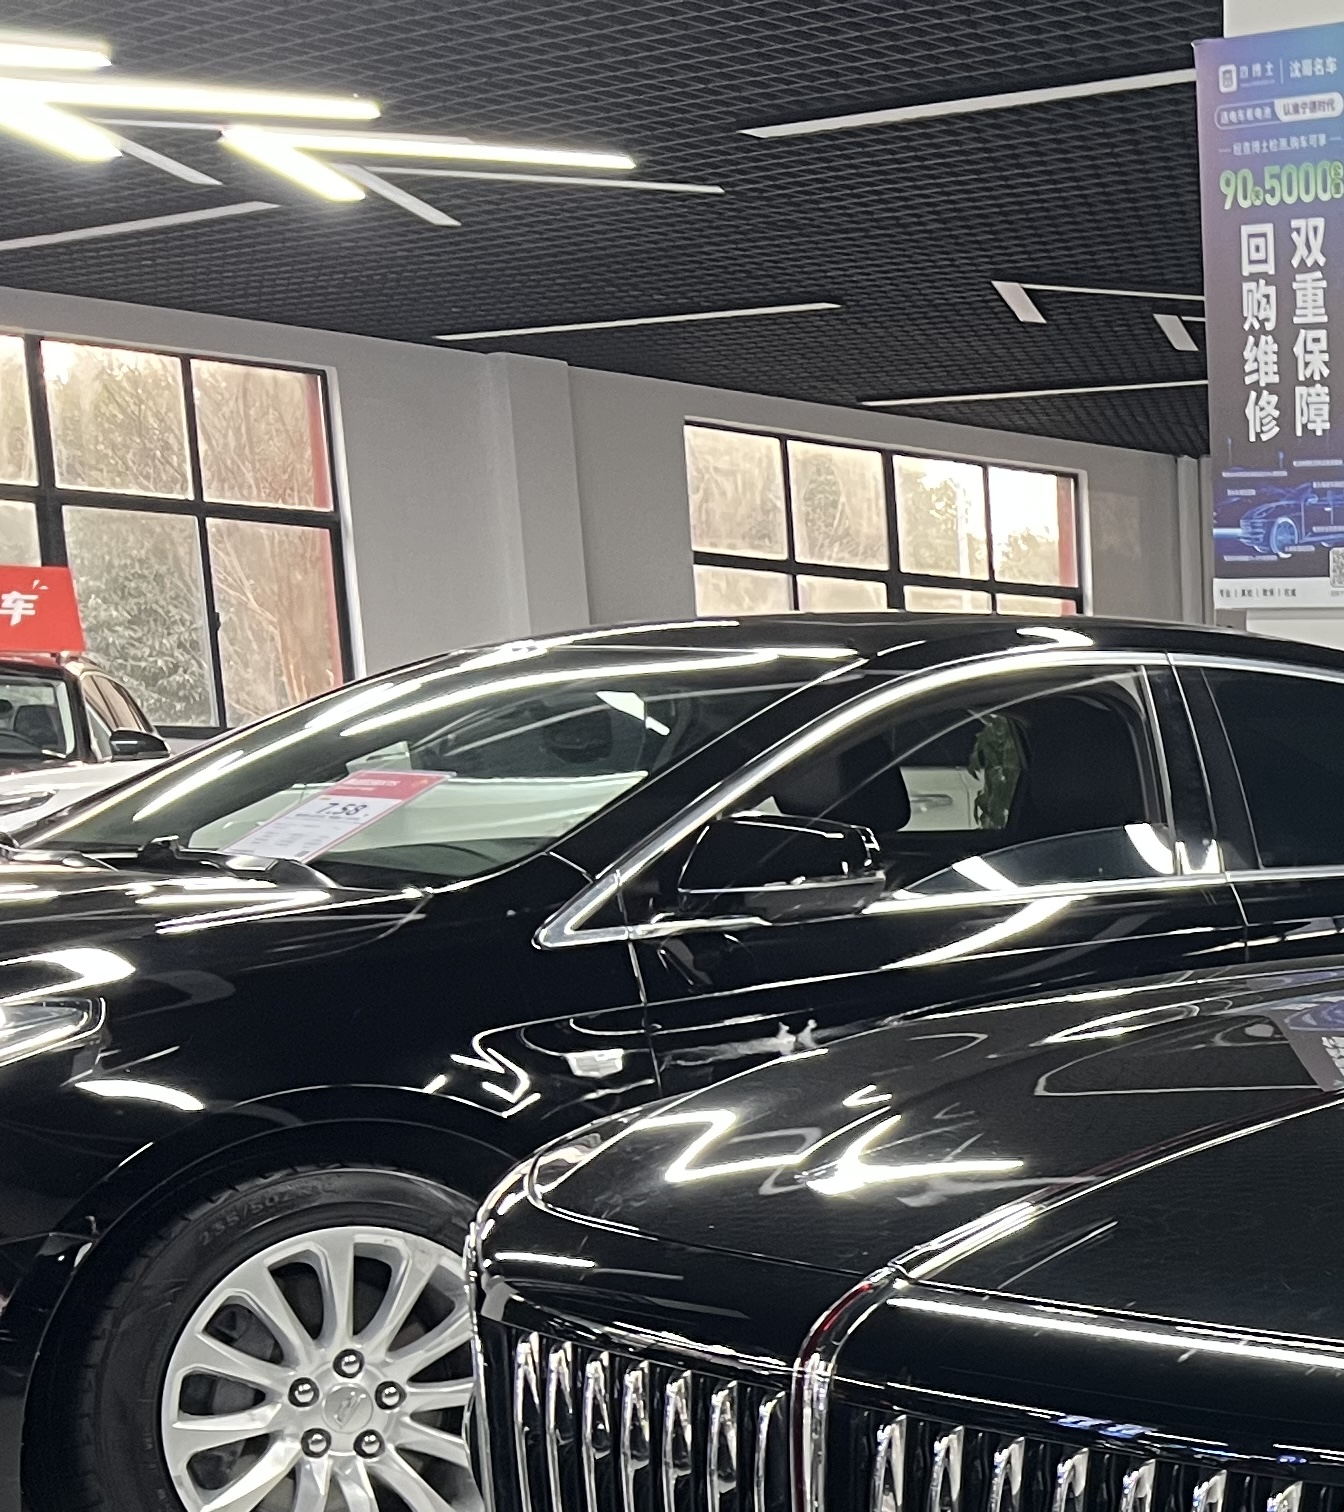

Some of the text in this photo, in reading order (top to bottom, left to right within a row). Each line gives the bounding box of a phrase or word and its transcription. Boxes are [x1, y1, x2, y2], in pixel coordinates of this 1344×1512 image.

[1241, 222, 1281, 443] 回购维修
[1290, 216, 1331, 437] 双重保障
[0, 590, 39, 627] 车
